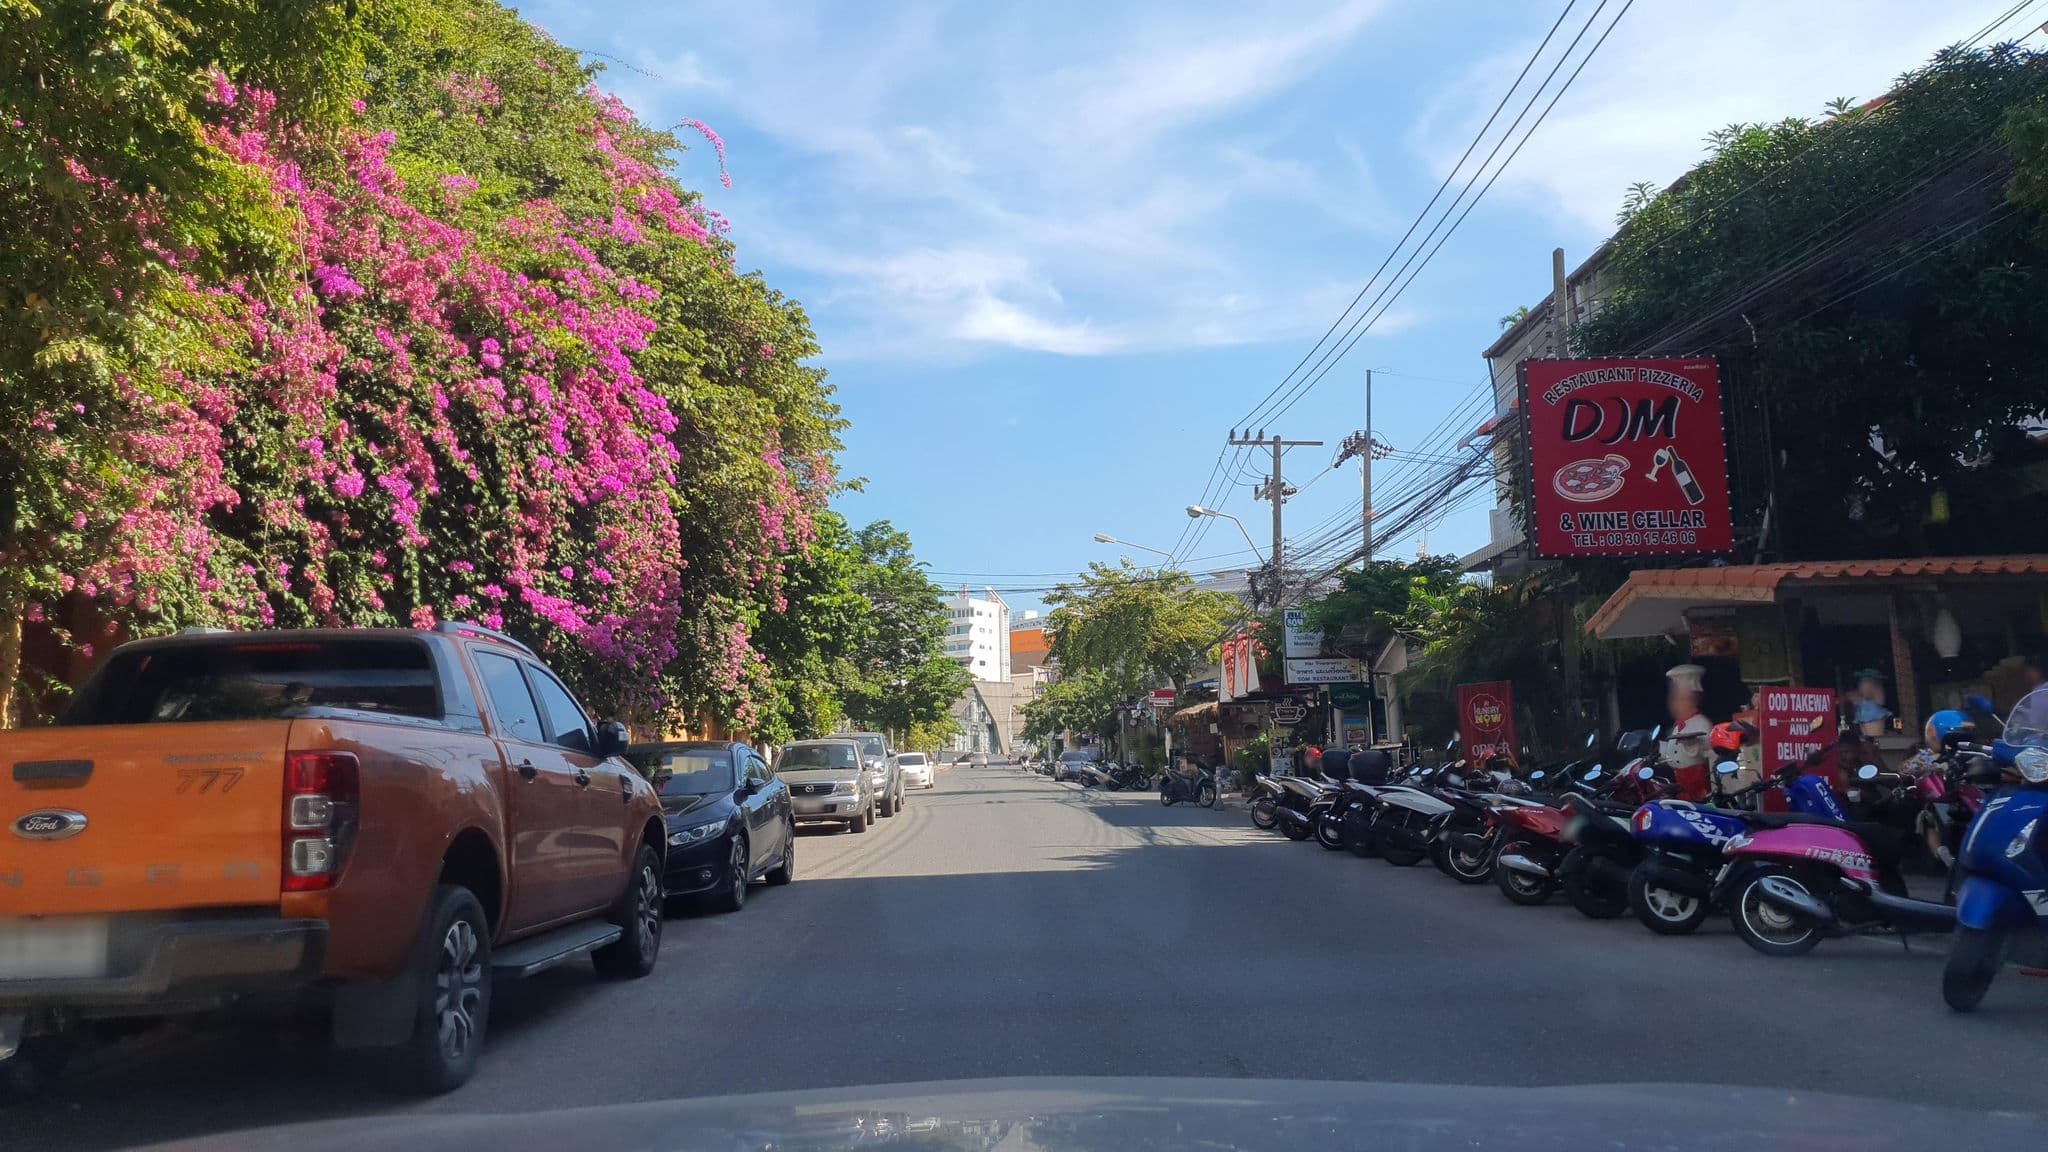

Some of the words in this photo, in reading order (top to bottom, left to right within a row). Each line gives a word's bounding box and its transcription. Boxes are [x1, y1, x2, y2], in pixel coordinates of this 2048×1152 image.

[1543, 368, 1636, 406] RESTAURANT
[1639, 368, 1705, 403] PIZZERIA
[1560, 513, 1575, 531] &
[1578, 512, 1629, 531] WINE
[1632, 511, 1706, 529] CELLAR
[1607, 533, 1622, 546] 08
[1625, 533, 1641, 546] 30
[1643, 532, 1659, 545] 15
[1662, 532, 1678, 545] 46
[1680, 531, 1696, 544] 06
[1474, 713, 1502, 725] NOW
[176, 767, 245, 795] 777
[25, 816, 59, 832] Ford
